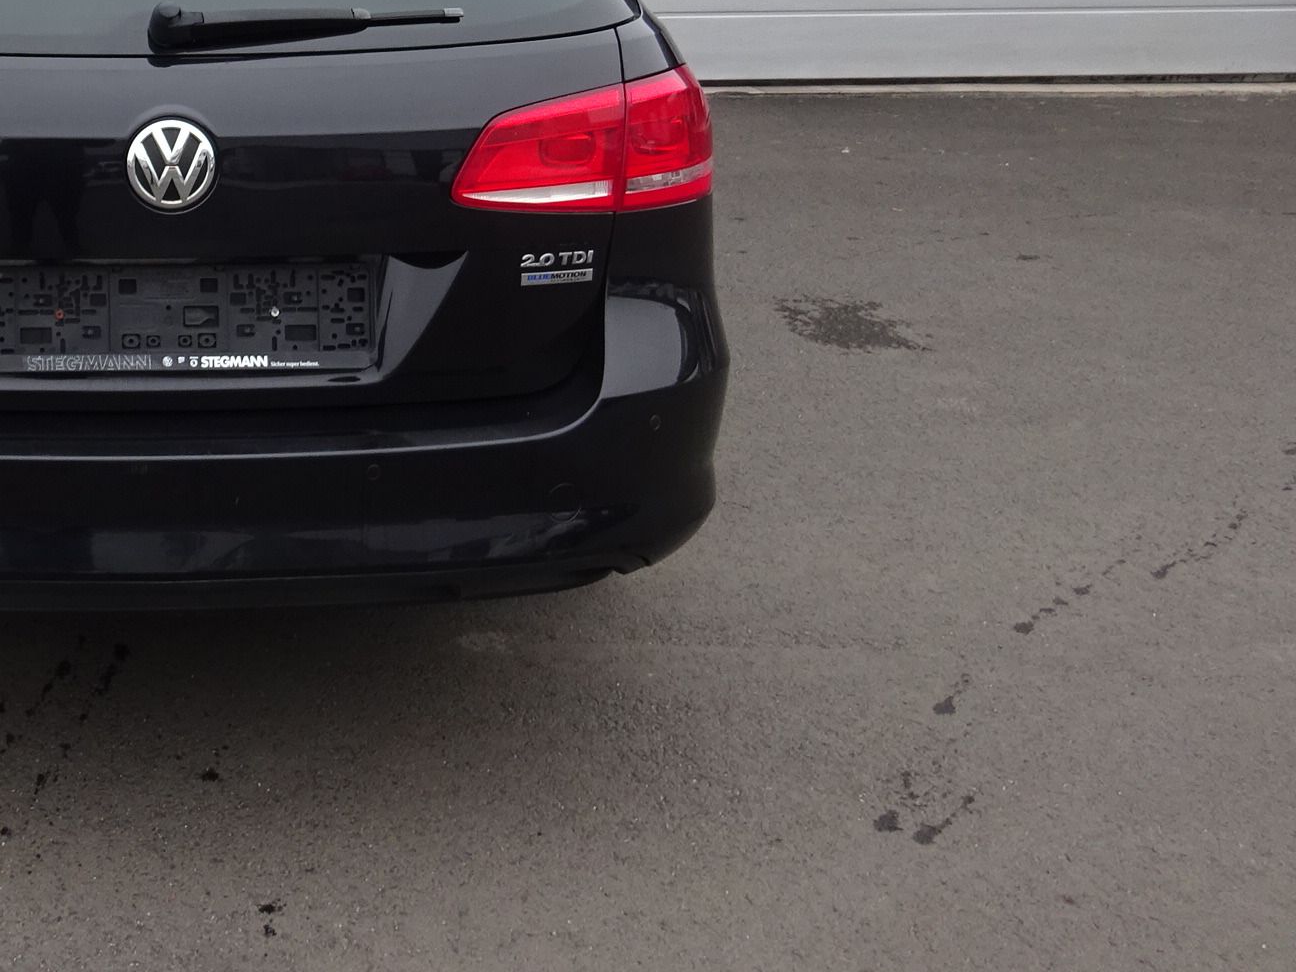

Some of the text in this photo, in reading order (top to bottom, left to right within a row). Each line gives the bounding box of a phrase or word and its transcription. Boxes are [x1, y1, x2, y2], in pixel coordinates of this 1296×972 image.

[558, 249, 594, 266] TDI
[27, 354, 152, 371] STEGMANN
[201, 355, 268, 368] STEGMANN
